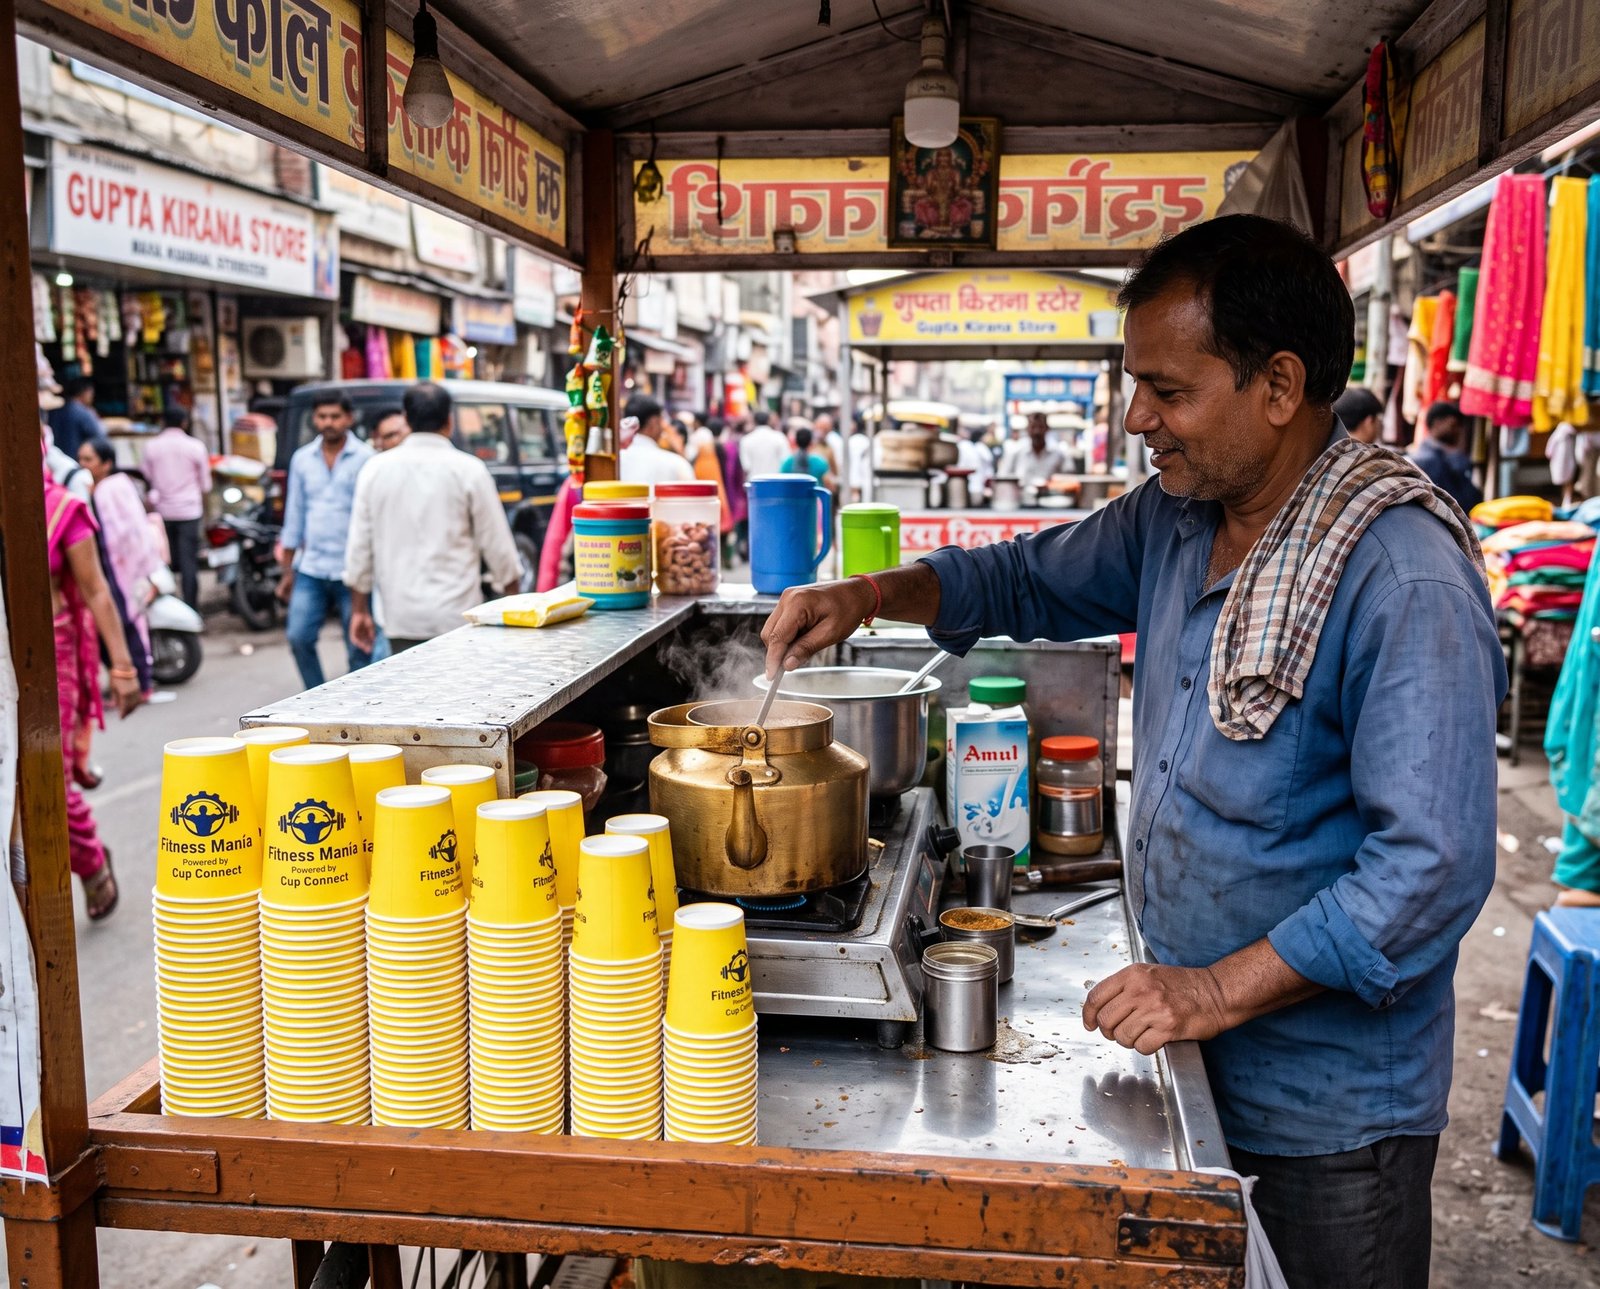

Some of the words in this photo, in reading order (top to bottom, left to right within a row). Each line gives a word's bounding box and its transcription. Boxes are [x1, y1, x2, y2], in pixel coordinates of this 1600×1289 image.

[67, 171, 154, 231] GUPTA
[161, 193, 244, 249] KIRANA
[249, 215, 307, 264] STORE
[958, 283, 1029, 313] किराना
[916, 320, 959, 335] Gupta
[964, 320, 1012, 333] Kirana
[1018, 320, 1057, 334] Store
[963, 744, 1019, 763] Amul
[161, 837, 206, 854] Fitness
[268, 845, 315, 862] Fitness
[182, 857, 217, 866] Powered
[219, 857, 229, 866] by
[291, 865, 326, 874] Powered
[327, 864, 337, 873] by
[172, 867, 192, 881] Cup
[195, 865, 242, 879] Connect
[280, 875, 301, 889] Cup
[303, 872, 349, 887] Connect
[420, 866, 455, 881] Fitness
[434, 887, 449, 897] Cup
[711, 986, 745, 1001] Fitness
[725, 1008, 740, 1017] Cup
